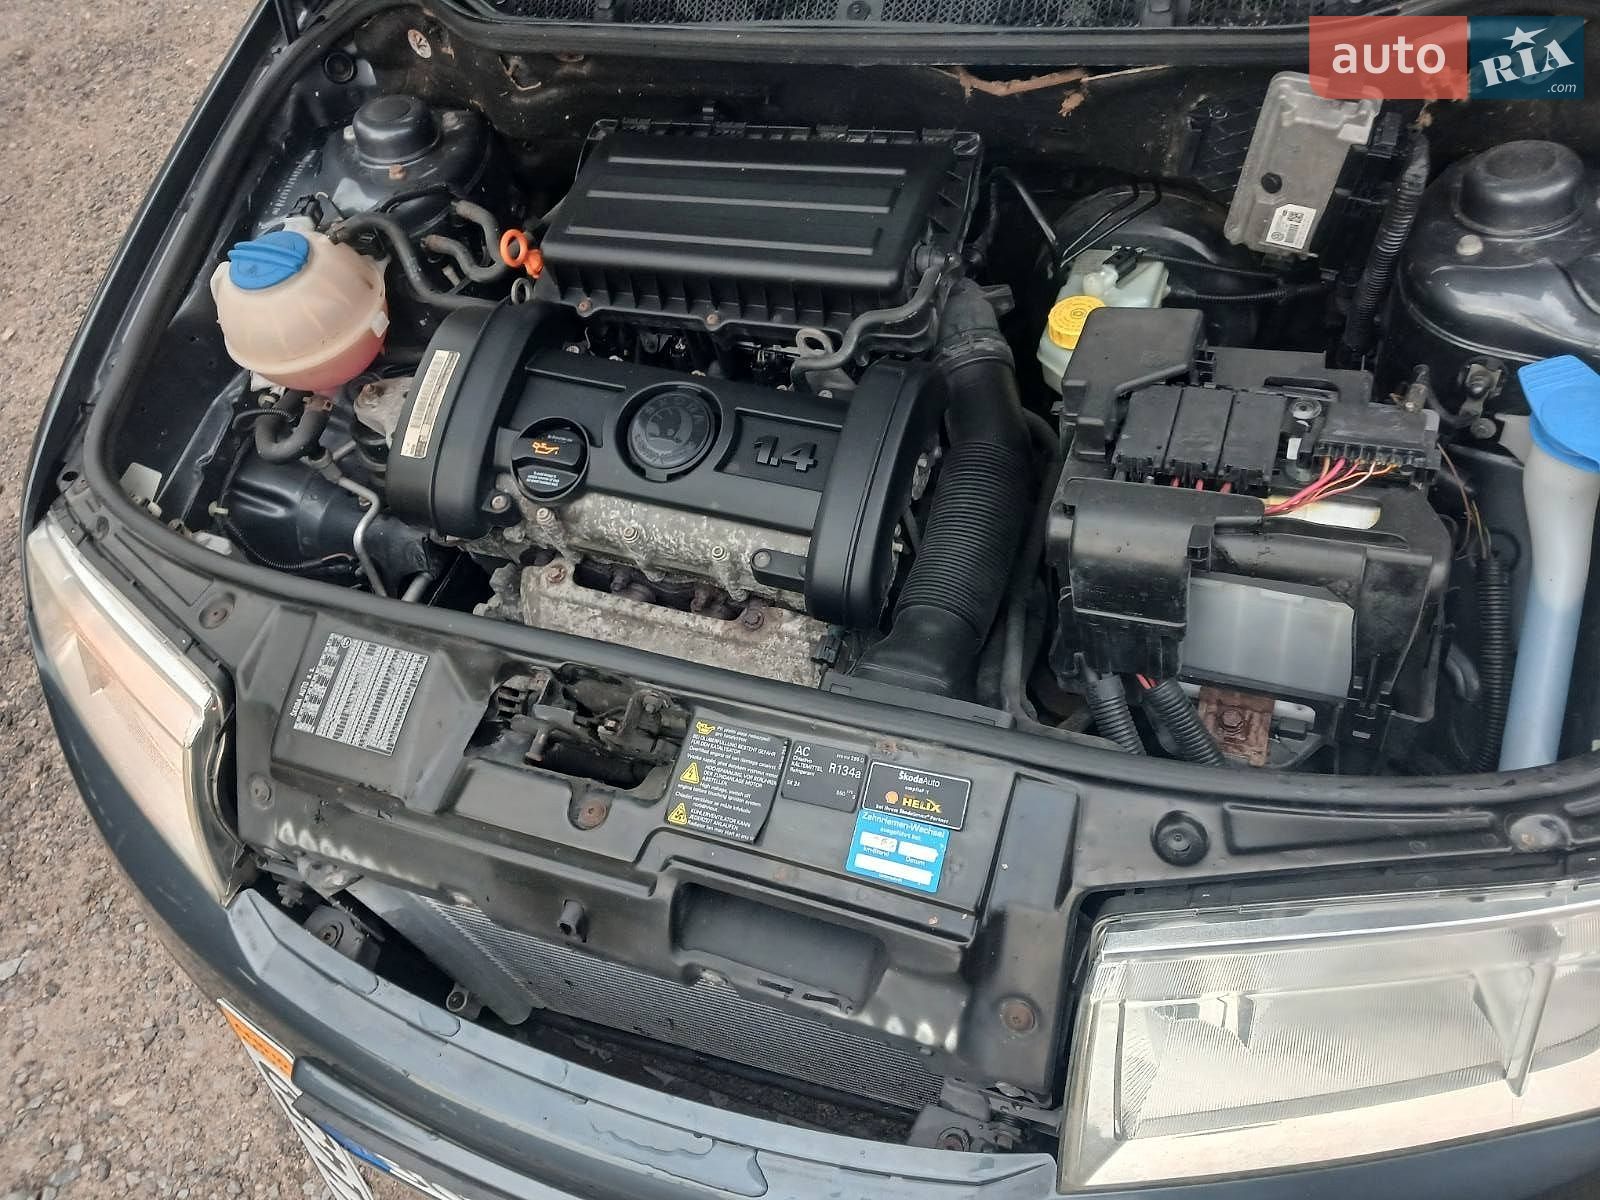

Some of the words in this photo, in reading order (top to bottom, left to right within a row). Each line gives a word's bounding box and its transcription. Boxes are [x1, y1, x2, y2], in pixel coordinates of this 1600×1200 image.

[754, 434, 818, 472] 1.4
[794, 744, 810, 756] AC
[828, 762, 862, 778] R134a
[898, 770, 941, 787] ŠkodaAuto
[902, 794, 943, 812] HELIX
